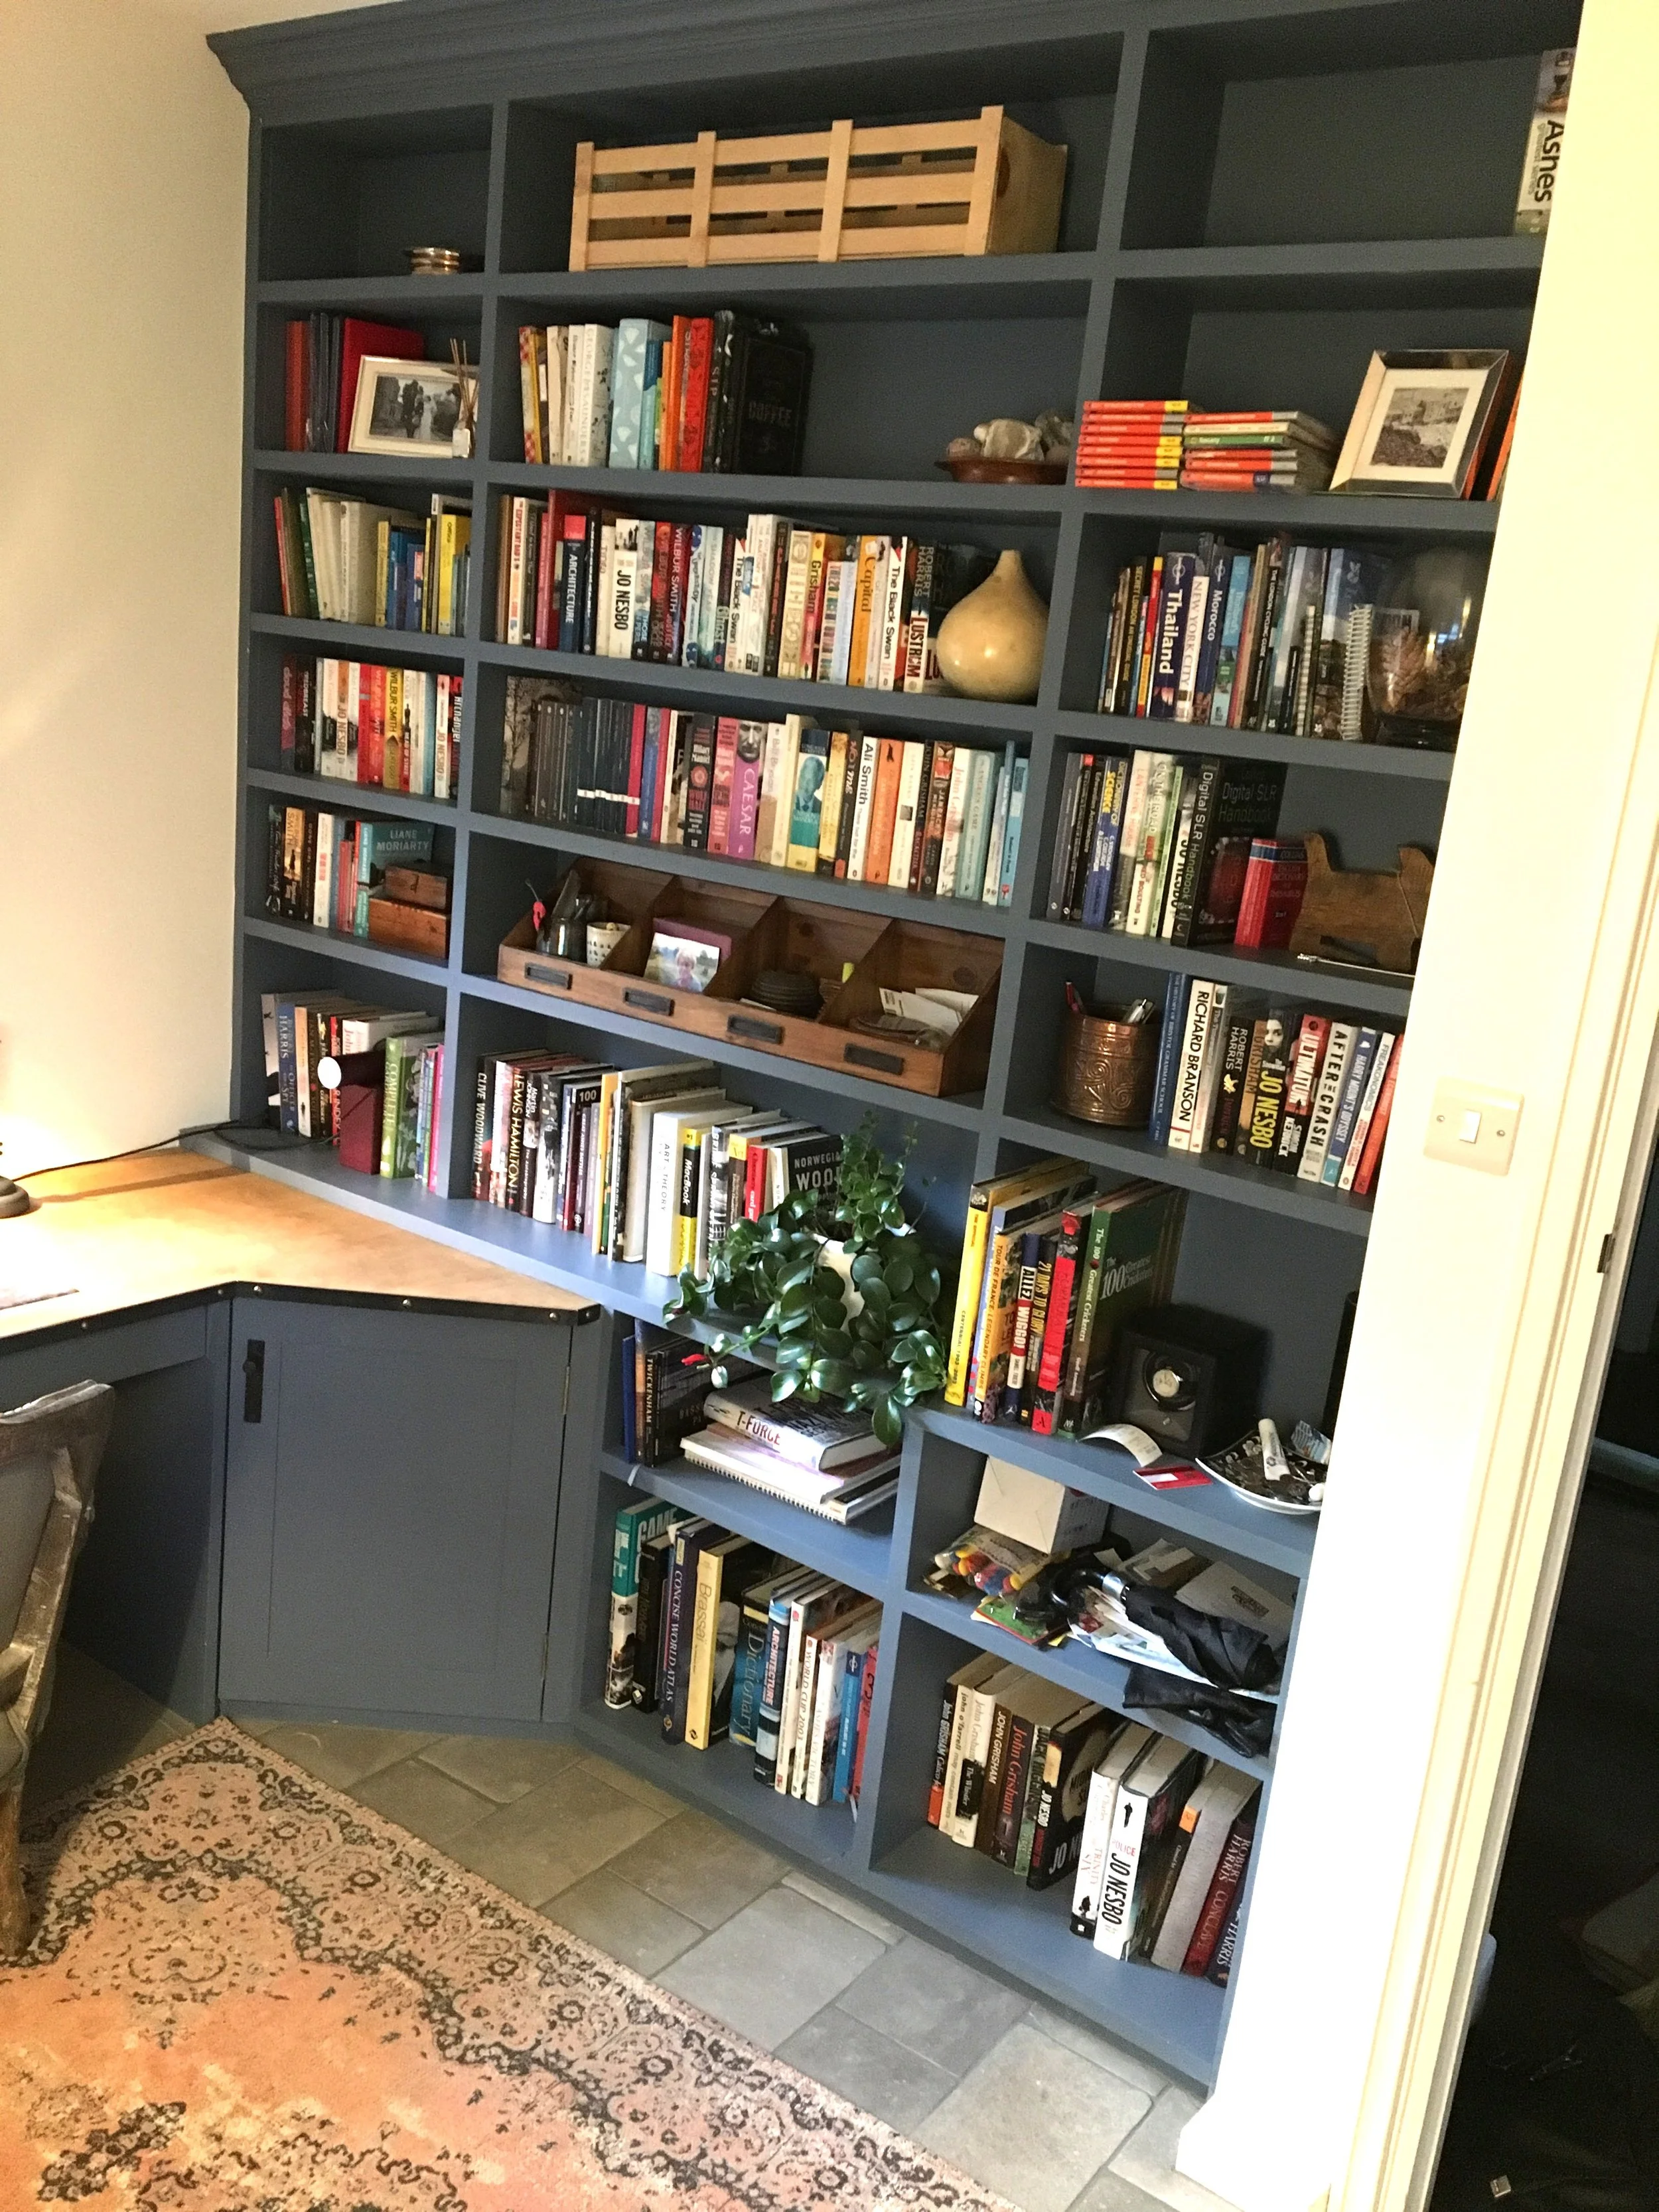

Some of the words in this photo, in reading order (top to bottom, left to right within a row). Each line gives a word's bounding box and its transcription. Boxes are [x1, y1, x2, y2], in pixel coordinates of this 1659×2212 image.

[1534, 120, 1565, 202] Ashes
[672, 528, 683, 573] WILBUR
[735, 557, 745, 577] The
[565, 554, 578, 624] ARCHITECTURE
[616, 569, 631, 587] JO
[807, 559, 822, 614] Grisham
[860, 556, 877, 613] Capital
[890, 565, 901, 589] The
[914, 546, 927, 597] HARRIS
[922, 546, 934, 598] ROBERT
[1133, 565, 1143, 593] SECRET
[614, 589, 630, 630] NESBO
[669, 575, 680, 613] SMITH
[733, 579, 743, 609] Black
[887, 591, 899, 623] Black
[1129, 595, 1139, 625] LONDON
[1192, 580, 1203, 611] NEW
[1267, 583, 1275, 610] LONDON
[715, 605, 729, 644] Ghost
[729, 613, 740, 644] Swan
[1159, 588, 1183, 674] Thailand
[1185, 615, 1199, 650] YORK
[1207, 589, 1222, 641] Morocco
[1263, 611, 1272, 637] CYCLING
[884, 626, 895, 659] Swan
[906, 617, 928, 678] LUSTRUM
[1259, 638, 1268, 657] GUIDE
[1181, 654, 1194, 686] CITY
[390, 672, 399, 704] WILBUR
[337, 704, 346, 719] JO
[389, 706, 397, 733] SMITH
[336, 721, 345, 755] NESBO
[437, 729, 445, 742] JO
[863, 743, 874, 761] Ali
[436, 744, 445, 774] NESBO
[922, 744, 932, 771] JOHN
[739, 768, 755, 835] CAESAR
[858, 765, 871, 805] Smith
[918, 773, 930, 818] GRISHAM
[1102, 770, 1116, 814] SCIENCE
[1113, 761, 1127, 812] DICTIONARY
[1152, 782, 1165, 803] THE
[1196, 772, 1214, 811] Digital
[1222, 782, 1255, 804] Digital
[1256, 784, 1277, 802] SLR
[390, 829, 418, 840] LIANE
[1148, 804, 1161, 832] ROAD
[1192, 813, 1206, 840] SLR
[376, 842, 429, 851] MORIARTY
[1181, 843, 1200, 901] Handbook
[1135, 880, 1146, 914] BOULTING
[279, 1015, 289, 1060] HARRIS
[1190, 991, 1210, 1053] RICHARD
[1225, 1027, 1240, 1070] HARRIS
[1234, 1029, 1248, 1072] ROBERT
[1246, 1035, 1263, 1094] GRISHAM
[1324, 1030, 1348, 1082] AFTER
[1159, 1050, 1170, 1086] GRAMMAR
[1260, 1070, 1283, 1094] JO
[1288, 1032, 1321, 1107] ULTIMATUM
[1350, 1053, 1368, 1081] HARRY
[1363, 1043, 1390, 1112] FREAKONOMICS
[385, 1063, 399, 1126] COMPLETE
[476, 1072, 487, 1100] CLIVE
[511, 1074, 525, 1114] LEWIS
[579, 1090, 597, 1102] 100
[1179, 1054, 1200, 1122] BRANSON
[1342, 1079, 1361, 1110] MOUNT'S
[472, 1102, 486, 1164] WOODWARD
[1250, 1095, 1279, 1148] NESBO
[1277, 1116, 1294, 1158] KERNICK
[1309, 1094, 1334, 1147] CRASH
[1335, 1110, 1353, 1143] ODYSSEY
[508, 1116, 523, 1188] HAMILTON
[1289, 1124, 1302, 1154] SIMON
[660, 1173, 669, 1213] THEORY
[682, 1159, 693, 1205] MacBook
[994, 1244, 1003, 1262] TOUR
[1092, 1245, 1102, 1260] 100
[1095, 1228, 1105, 1244] The
[993, 1264, 1000, 1276] DE
[1038, 1260, 1052, 1272] 21
[1100, 1264, 1126, 1301] 100
[1019, 1268, 1035, 1301] ALLEZ
[1033, 1297, 1048, 1307] TO
[1035, 1273, 1050, 1296] DAYS
[1084, 1270, 1098, 1307] Greatest
[957, 1310, 967, 1347] CENTENNIAL
[982, 1313, 994, 1359] LEGENDARY
[1012, 1305, 1031, 1349] WIGGO!
[1030, 1307, 1046, 1336] GLORY
[1078, 1308, 1092, 1343] Cricketers
[977, 1360, 988, 1390] CLIMBS
[737, 1410, 782, 1446] T-FORCE
[670, 1570, 684, 1621] CONCISE
[666, 1623, 681, 1668] WORLD
[765, 1625, 781, 1705] ARCHITECTURE
[800, 1651, 812, 1690] WORLD
[664, 1667, 678, 1702] ATLAS
[733, 1633, 764, 1735] Dictionary
[799, 1692, 809, 1715] CUP
[942, 1700, 953, 1719] John
[959, 1692, 969, 1714] john
[974, 1700, 985, 1723] John
[811, 1706, 822, 1739] ASHES
[936, 1719, 952, 1757] GRISHAM
[954, 1714, 966, 1751] o'farrell
[994, 1710, 1007, 1740] JOHN
[968, 1724, 983, 1761] Grisham
[1010, 1726, 1028, 1759] John
[1033, 1728, 1048, 1758] JACK
[806, 1739, 820, 1787] VICTORY
[934, 1756, 946, 1779] Calico
[966, 1766, 974, 1779] The
[987, 1739, 1003, 1785] GRISHAM
[1001, 1760, 1022, 1816] Grisham
[1028, 1759, 1045, 1805] HIGGINS
[1041, 1790, 1053, 1800] JO
[1037, 1801, 1051, 1828] NESBO
[1110, 1852, 1132, 1876] JO
[1112, 1838, 1137, 1858] POLICE
[1217, 1832, 1241, 1883] HARRIS
[1227, 1838, 1252, 1885] ROBERT
[1088, 1847, 1104, 1885] TRINITY
[1100, 1876, 1128, 1925] NESBO
[1195, 1889, 1230, 1955] CONCLAVE
[1215, 1920, 1239, 1968] HARRIS
